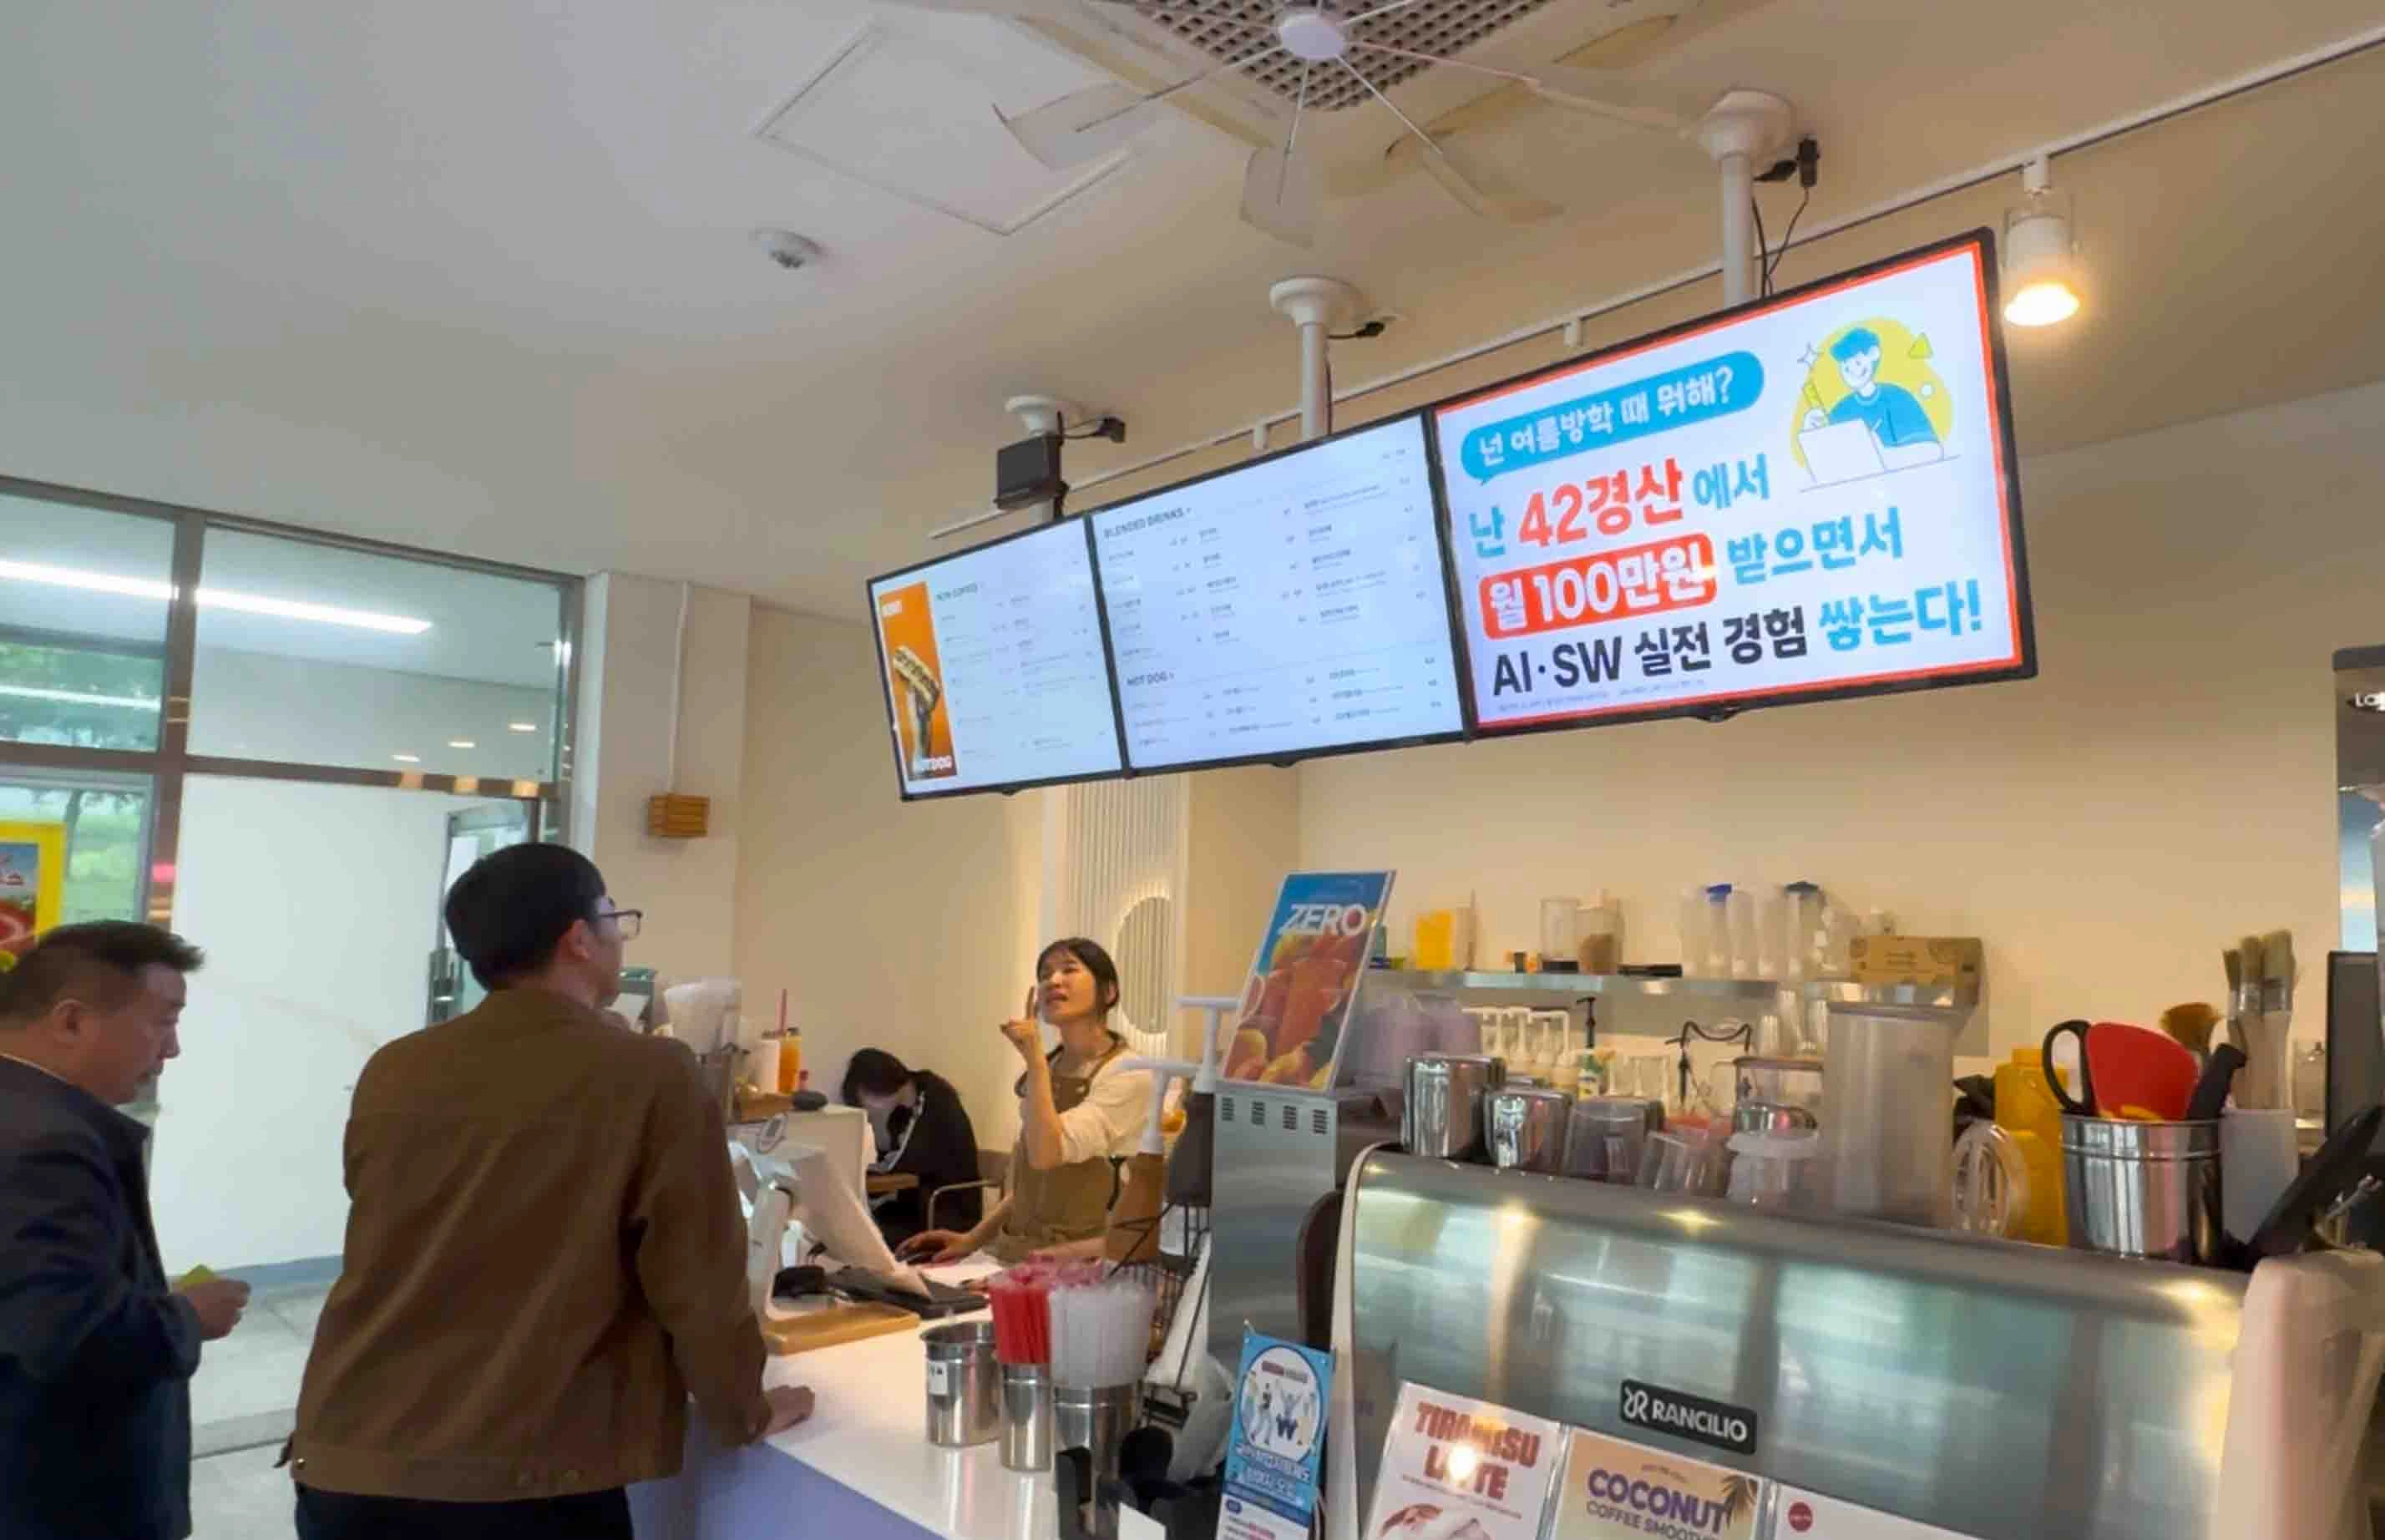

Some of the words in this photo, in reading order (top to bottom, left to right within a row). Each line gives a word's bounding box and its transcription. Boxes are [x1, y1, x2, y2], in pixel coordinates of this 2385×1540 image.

[1479, 431, 1505, 467] 넌
[1511, 400, 1614, 453] 여름방학
[1621, 392, 1651, 425] 때
[1658, 366, 1734, 418] 뭐해?
[1469, 504, 1506, 559] 난
[1518, 456, 1684, 548] 42경산
[1692, 453, 1771, 509] 에서
[1490, 577, 1527, 631] 월
[1533, 541, 1715, 622] 100만원
[1727, 506, 1904, 585] 받으면서
[1633, 621, 1713, 677] 실전
[1723, 605, 1808, 666] 경험
[1818, 578, 1982, 652] 쌓는다!
[1279, 903, 1368, 936] ZERO
[1652, 1397, 1748, 1442] RANCILIO
[1424, 1444, 1509, 1500] LTE
[1587, 1468, 1727, 1533] COCONUT
[1587, 1500, 1640, 1530] COFFEE
